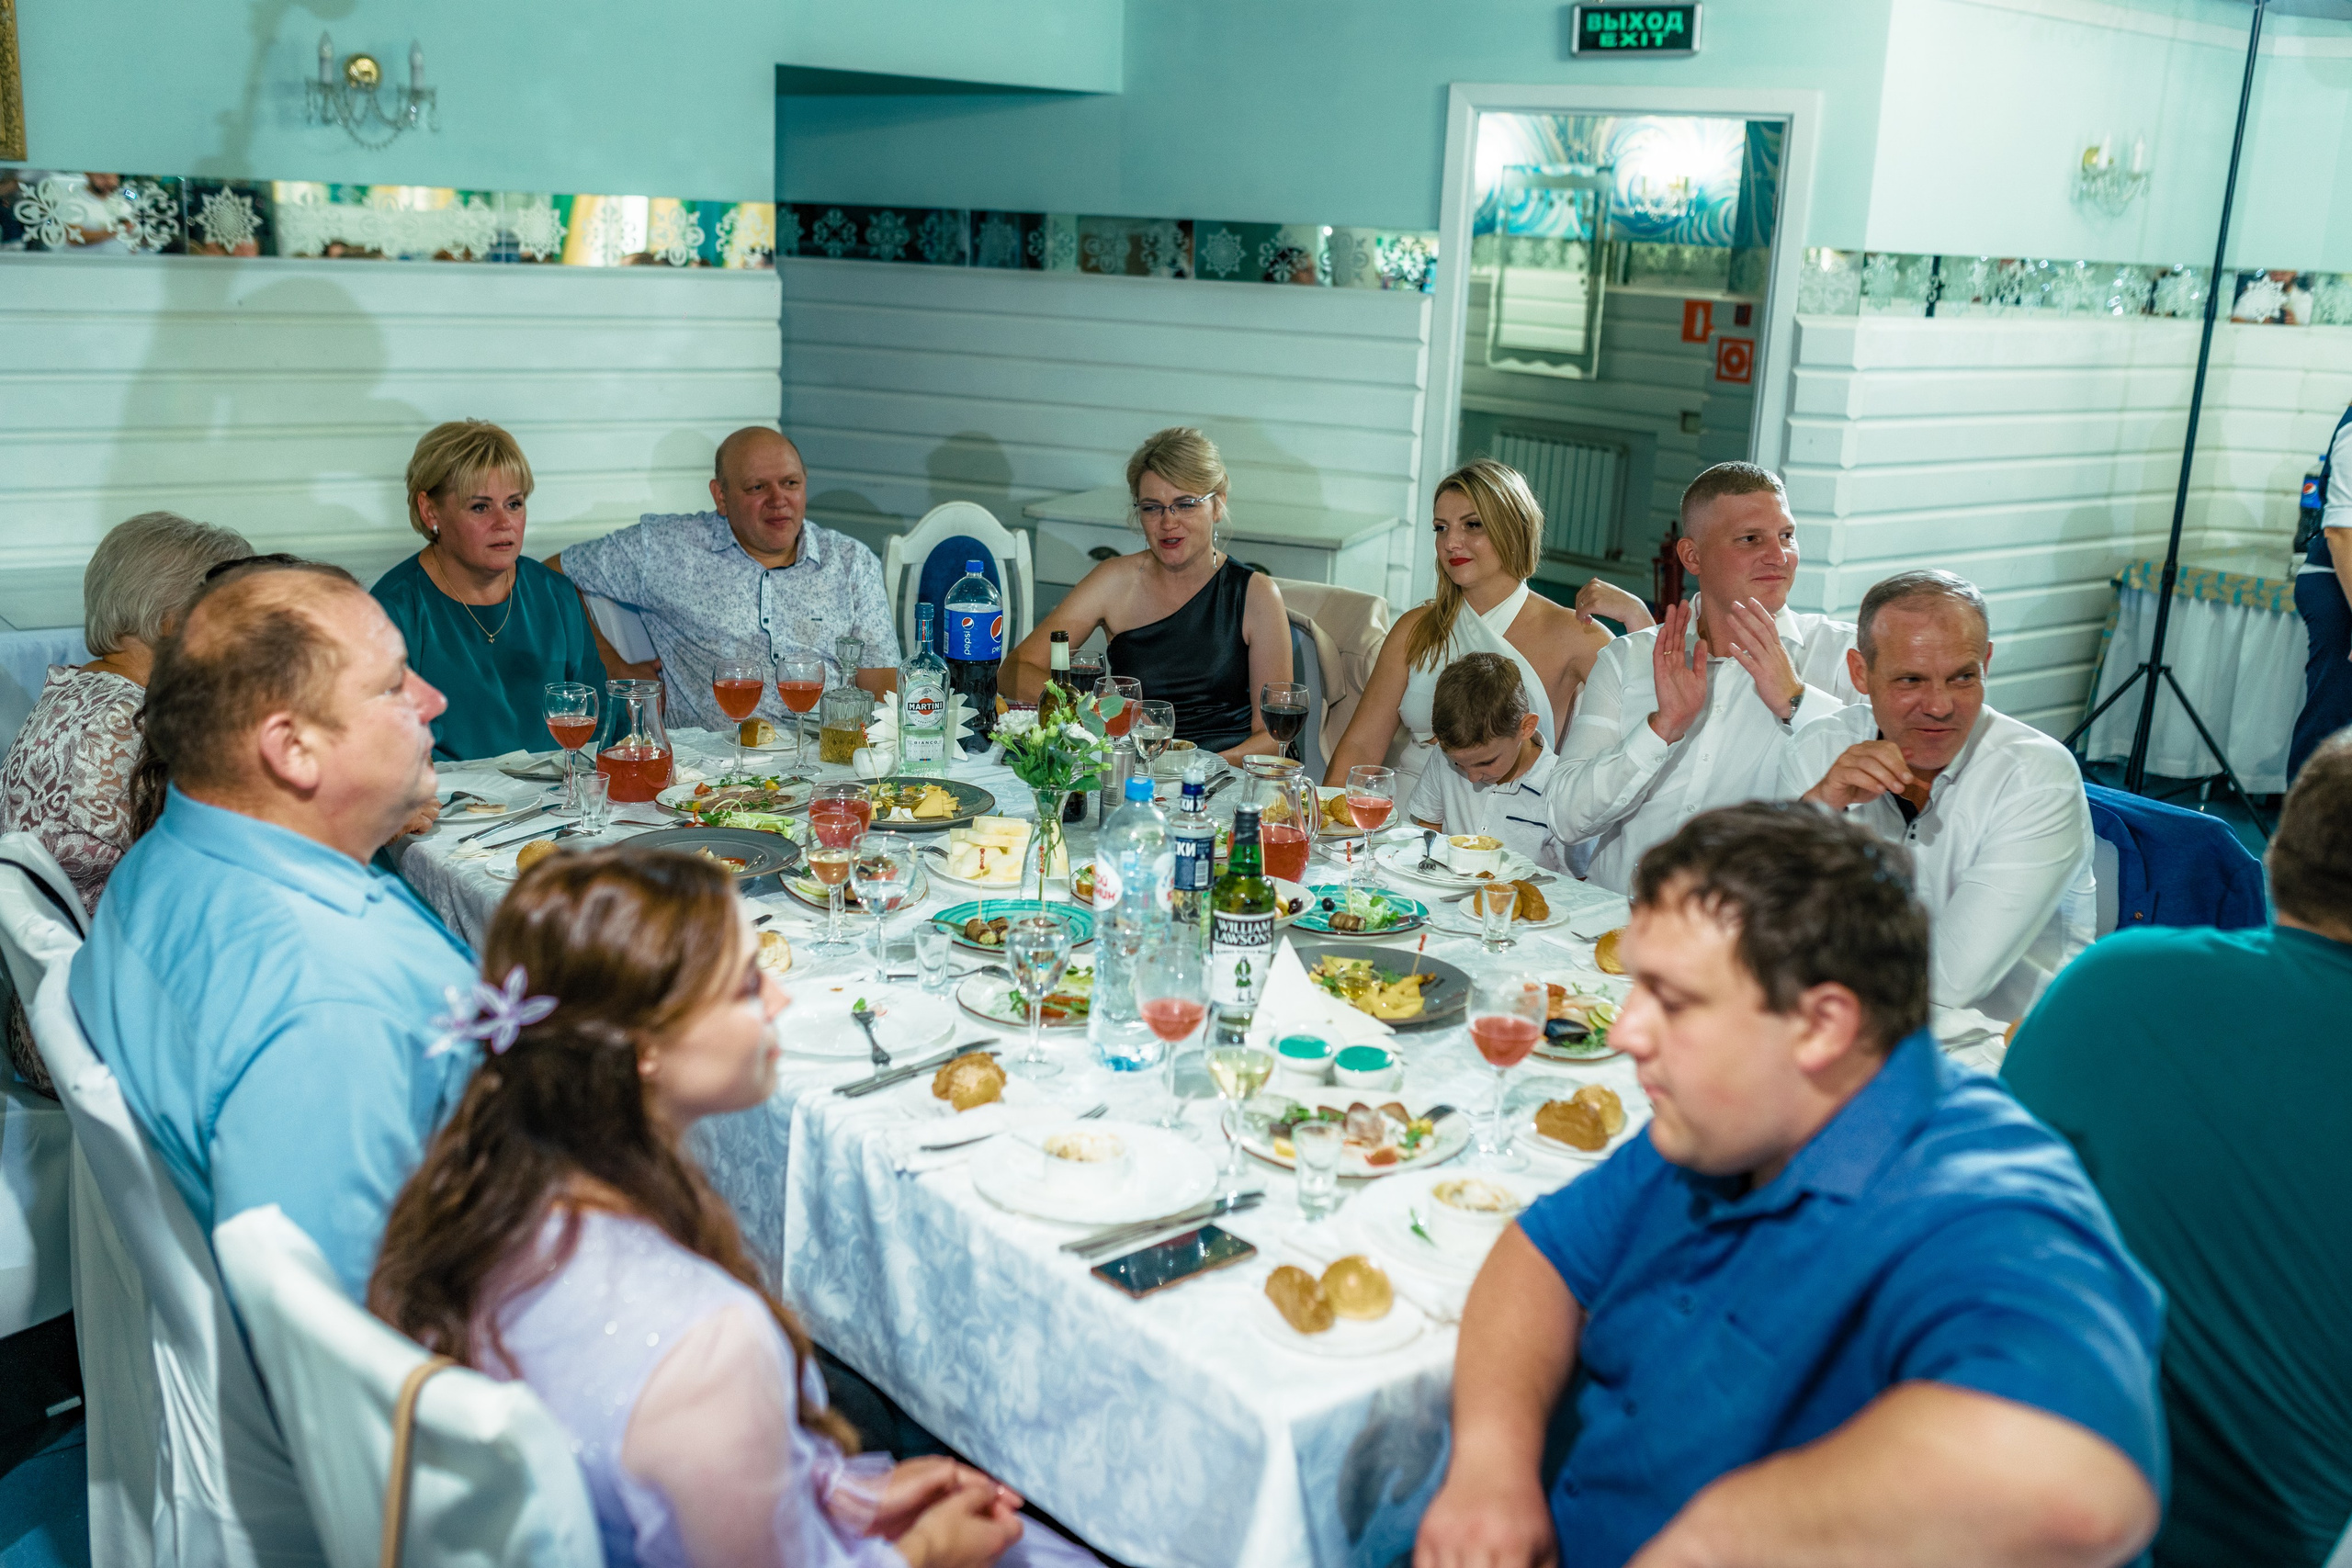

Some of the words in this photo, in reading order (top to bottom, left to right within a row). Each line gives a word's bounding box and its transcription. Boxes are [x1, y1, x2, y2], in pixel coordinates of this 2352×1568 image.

[1586, 10, 1684, 37] ВЫХОД
[1599, 30, 1664, 47] EXIT
[964, 630, 972, 655] pepsi
[909, 702, 943, 710] MARTINI
[1217, 918, 1272, 934] WILLIAM
